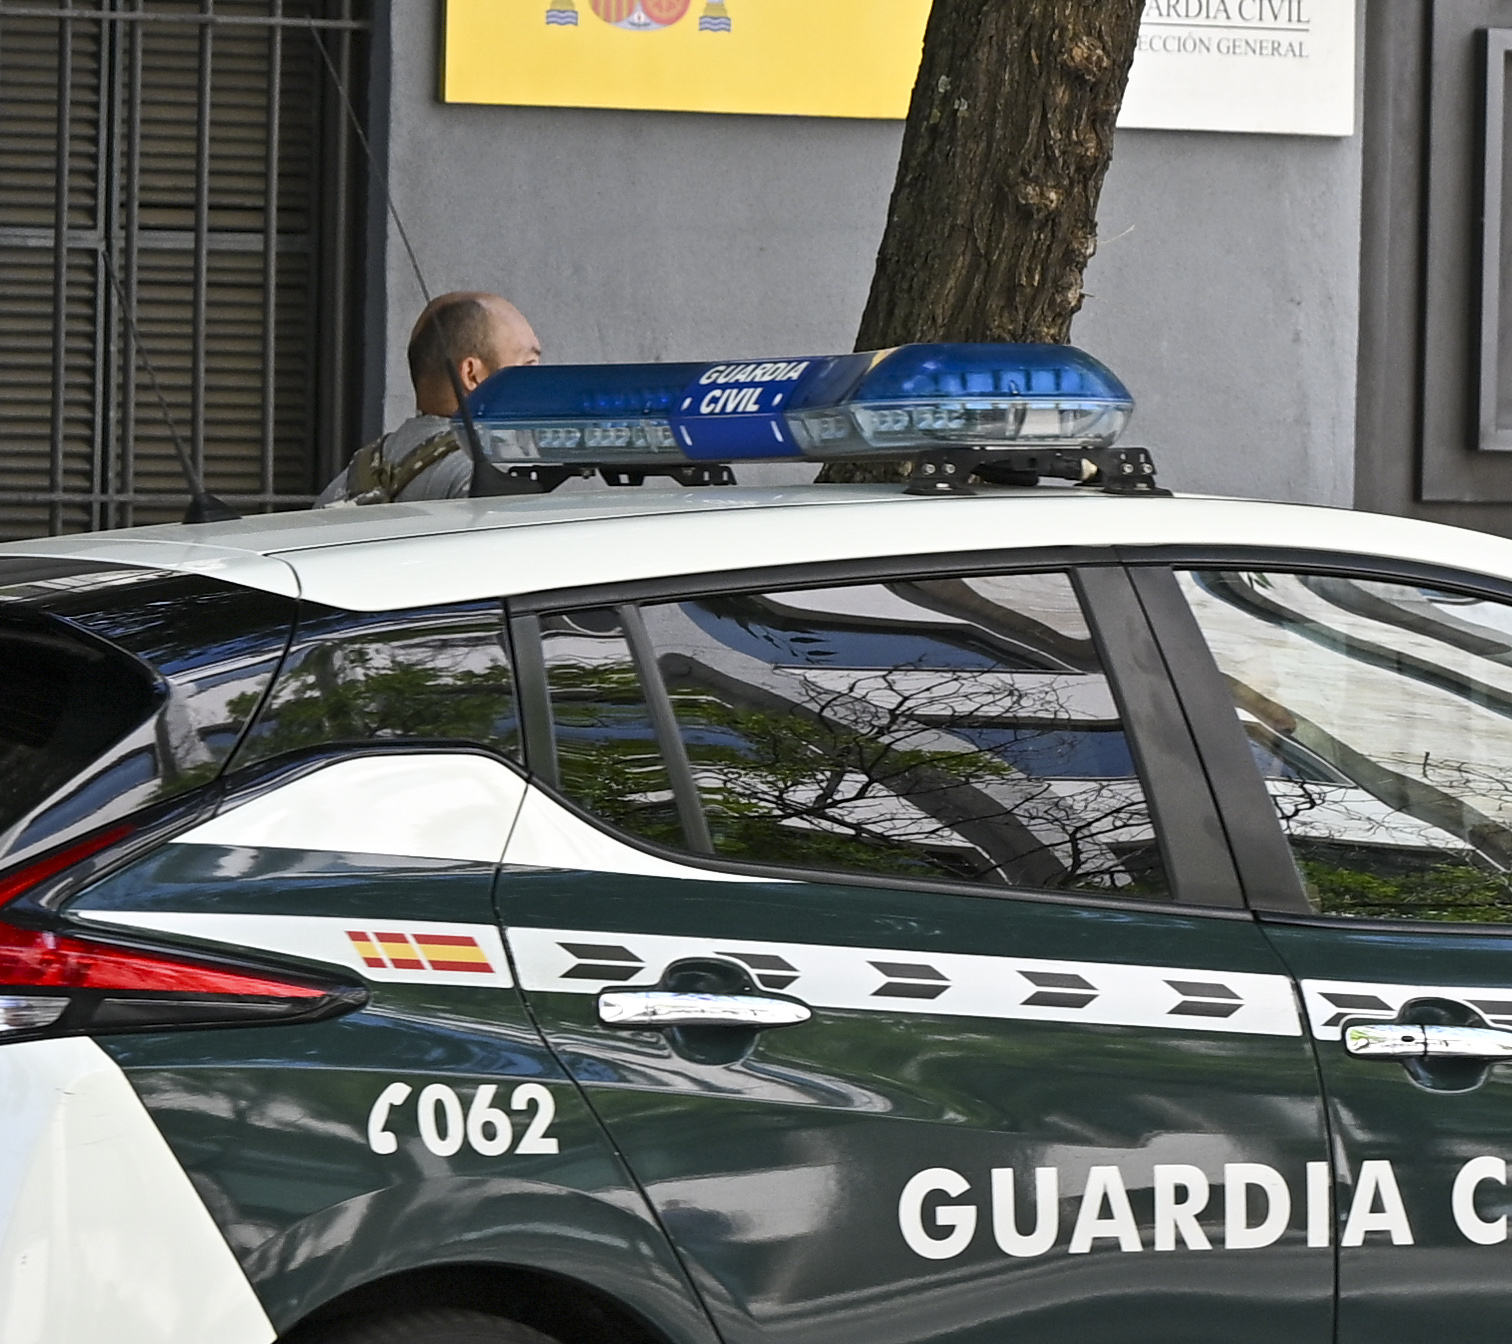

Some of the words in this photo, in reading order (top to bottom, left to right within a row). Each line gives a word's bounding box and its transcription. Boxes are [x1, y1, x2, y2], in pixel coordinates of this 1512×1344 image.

[1138, 32, 1212, 54] ECCIÓN
[1216, 37, 1309, 58] GENERAL
[699, 360, 808, 386] GUARDIA
[699, 387, 764, 416] CIVIL
[417, 1083, 560, 1157] 062
[898, 1159, 1415, 1261] GUARDIA
